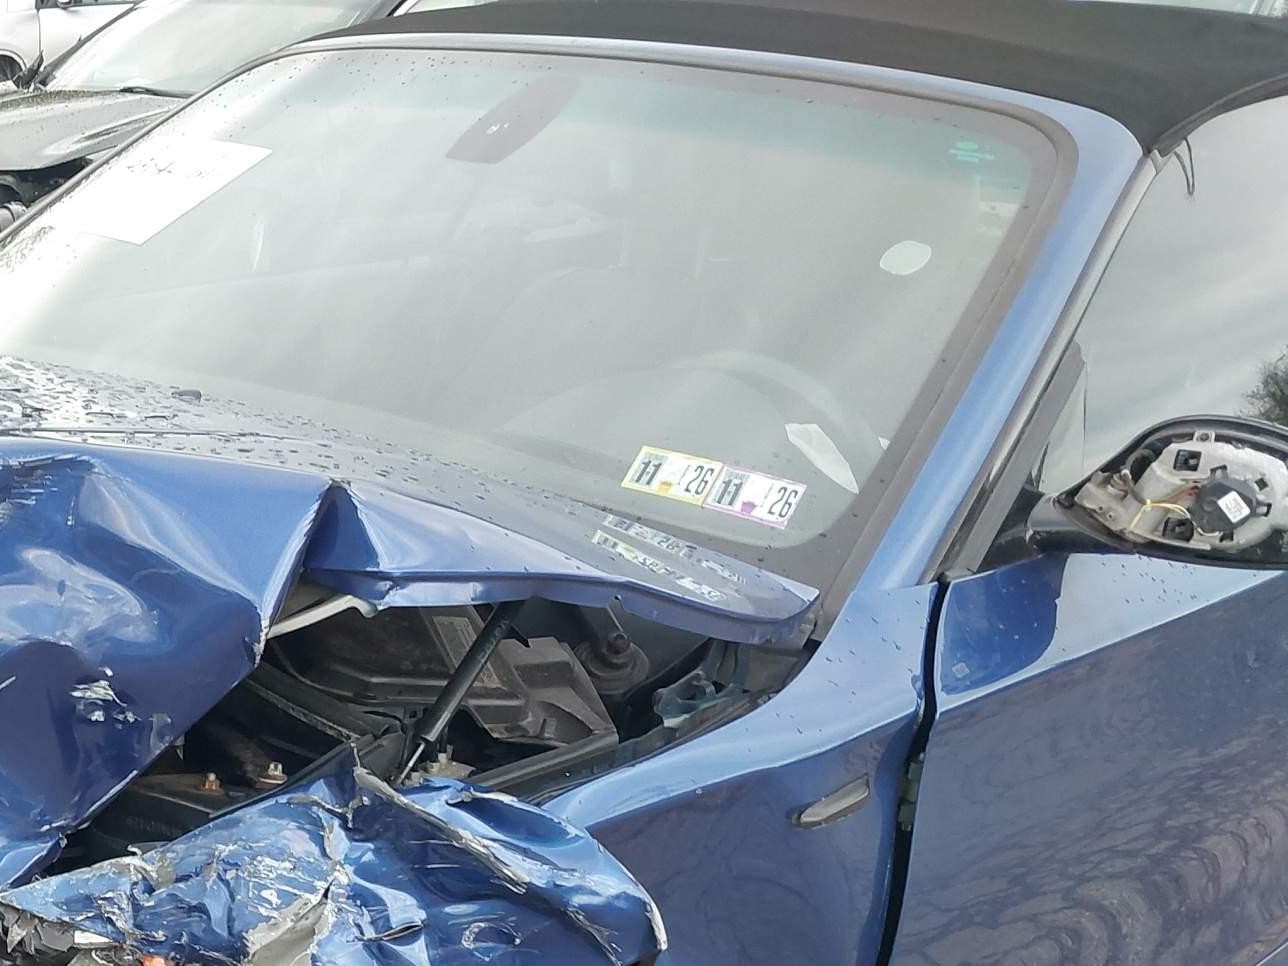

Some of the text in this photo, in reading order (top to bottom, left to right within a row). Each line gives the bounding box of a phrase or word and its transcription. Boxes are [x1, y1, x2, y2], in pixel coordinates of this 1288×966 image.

[635, 460, 715, 496] 11 26
[716, 479, 798, 518] 11 26
